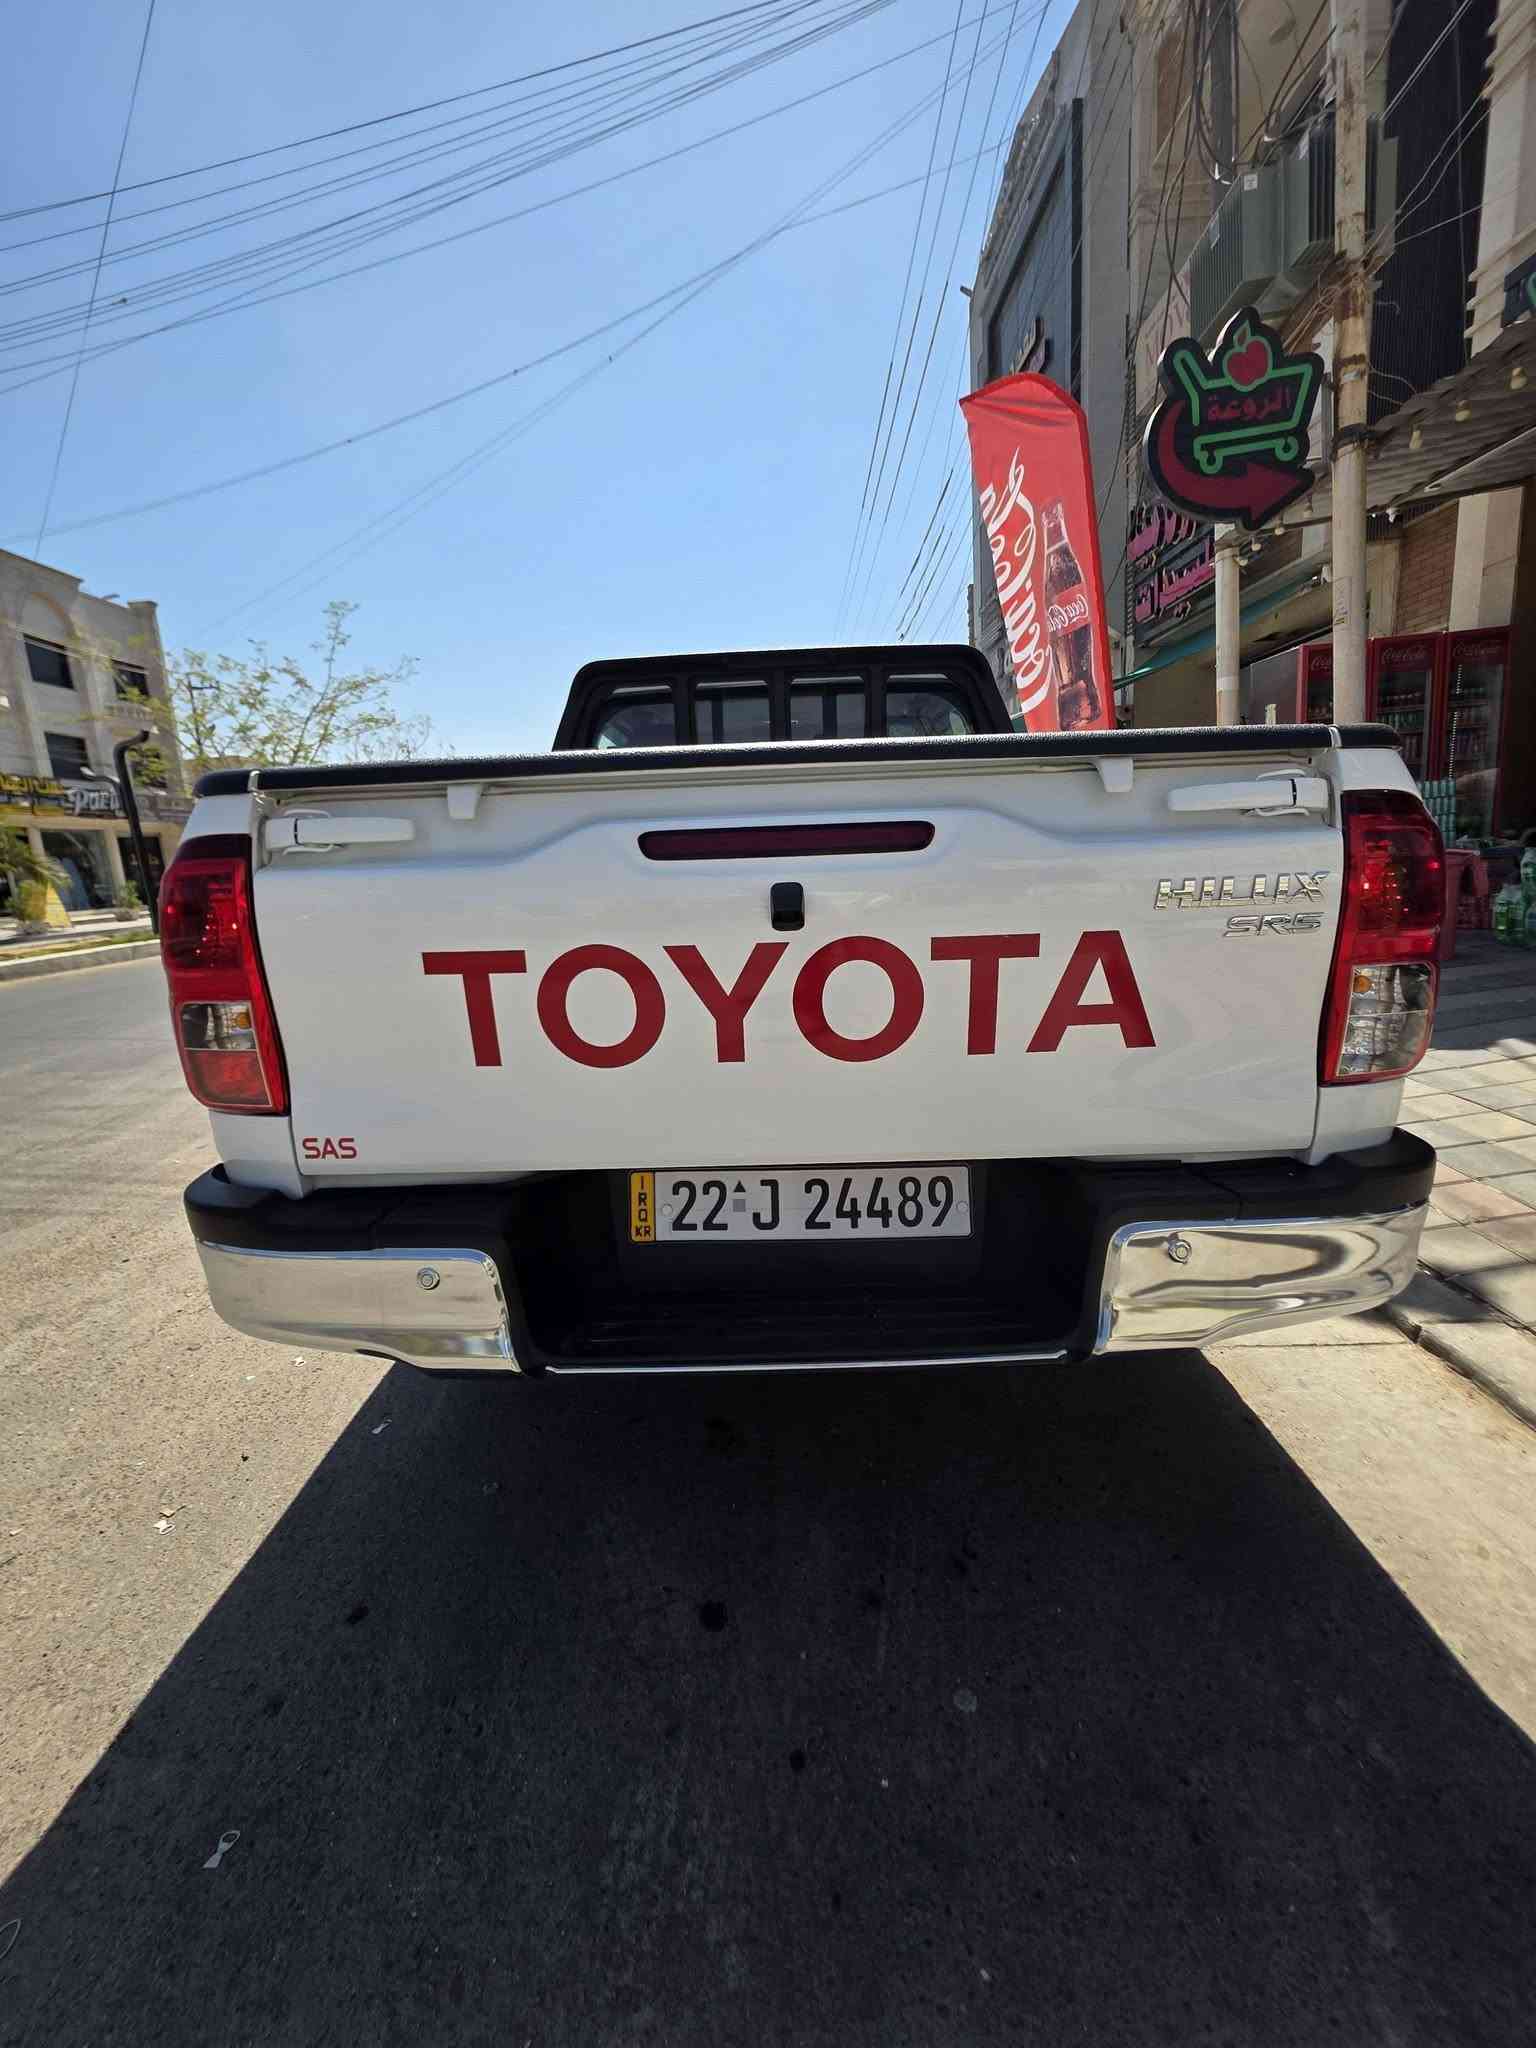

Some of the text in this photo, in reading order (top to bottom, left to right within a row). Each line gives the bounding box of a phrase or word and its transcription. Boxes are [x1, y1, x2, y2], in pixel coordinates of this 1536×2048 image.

[1153, 870, 1331, 911] HILUX
[1222, 911, 1326, 937] SR5
[421, 930, 1158, 1069] TOYOTA
[302, 1137, 357, 1160] SAS
[672, 1175, 954, 1231] 22 J 24489
[635, 1225, 651, 1237] KR
